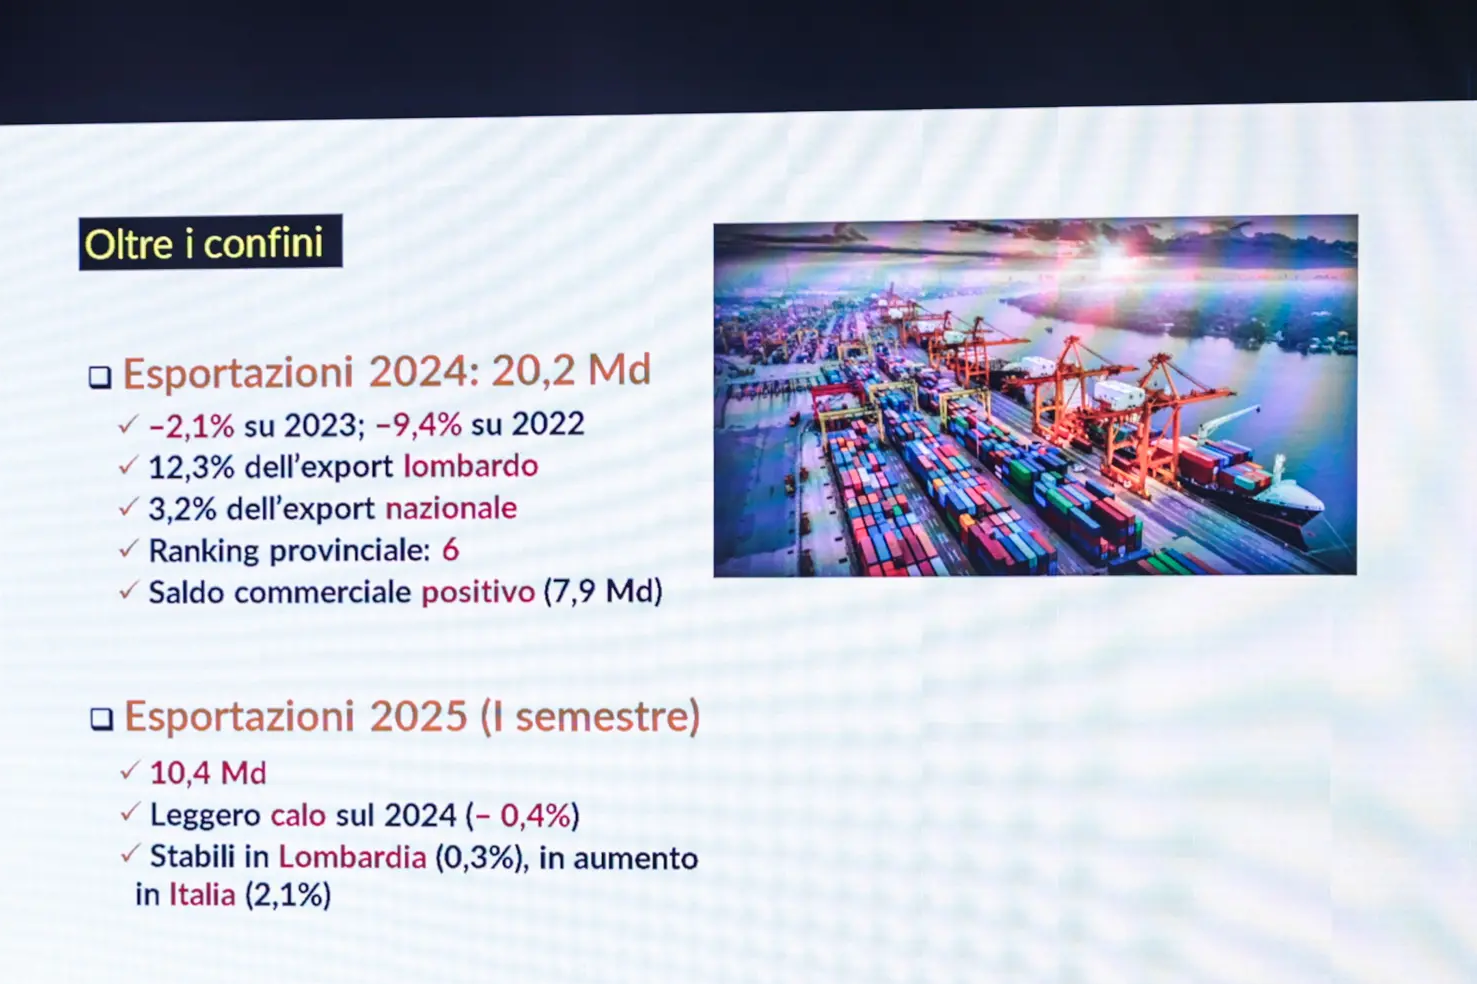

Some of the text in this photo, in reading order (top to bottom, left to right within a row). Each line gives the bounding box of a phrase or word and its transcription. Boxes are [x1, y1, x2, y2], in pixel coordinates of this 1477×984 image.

[85, 225, 322, 260] Oltre i confini
[125, 352, 650, 396] Esportazioni 2024: 20,2 Md
[245, 420, 274, 438] su
[284, 412, 364, 441] 2023;
[471, 418, 502, 436] su
[512, 410, 584, 436] 2022
[150, 454, 235, 483] 12,3%
[405, 453, 539, 478] lombardo
[149, 496, 217, 525] 3,2%
[387, 495, 517, 520] nazionale
[150, 537, 459, 567] Ranking provinciale: 6
[149, 577, 662, 608] Saldo commerciale positivo (7,9 Md)
[127, 697, 699, 738] Esportazioni 2025 (I semestre)
[151, 760, 266, 788] 10,4 Md
[152, 802, 260, 831] Leggero
[271, 802, 326, 826] calo
[336, 802, 373, 827] sul
[385, 803, 457, 827] 2024
[151, 843, 698, 874] Stabili in Lombardia (0,3%), in aumento
[137, 880, 330, 911] in Italia (2,1%)
